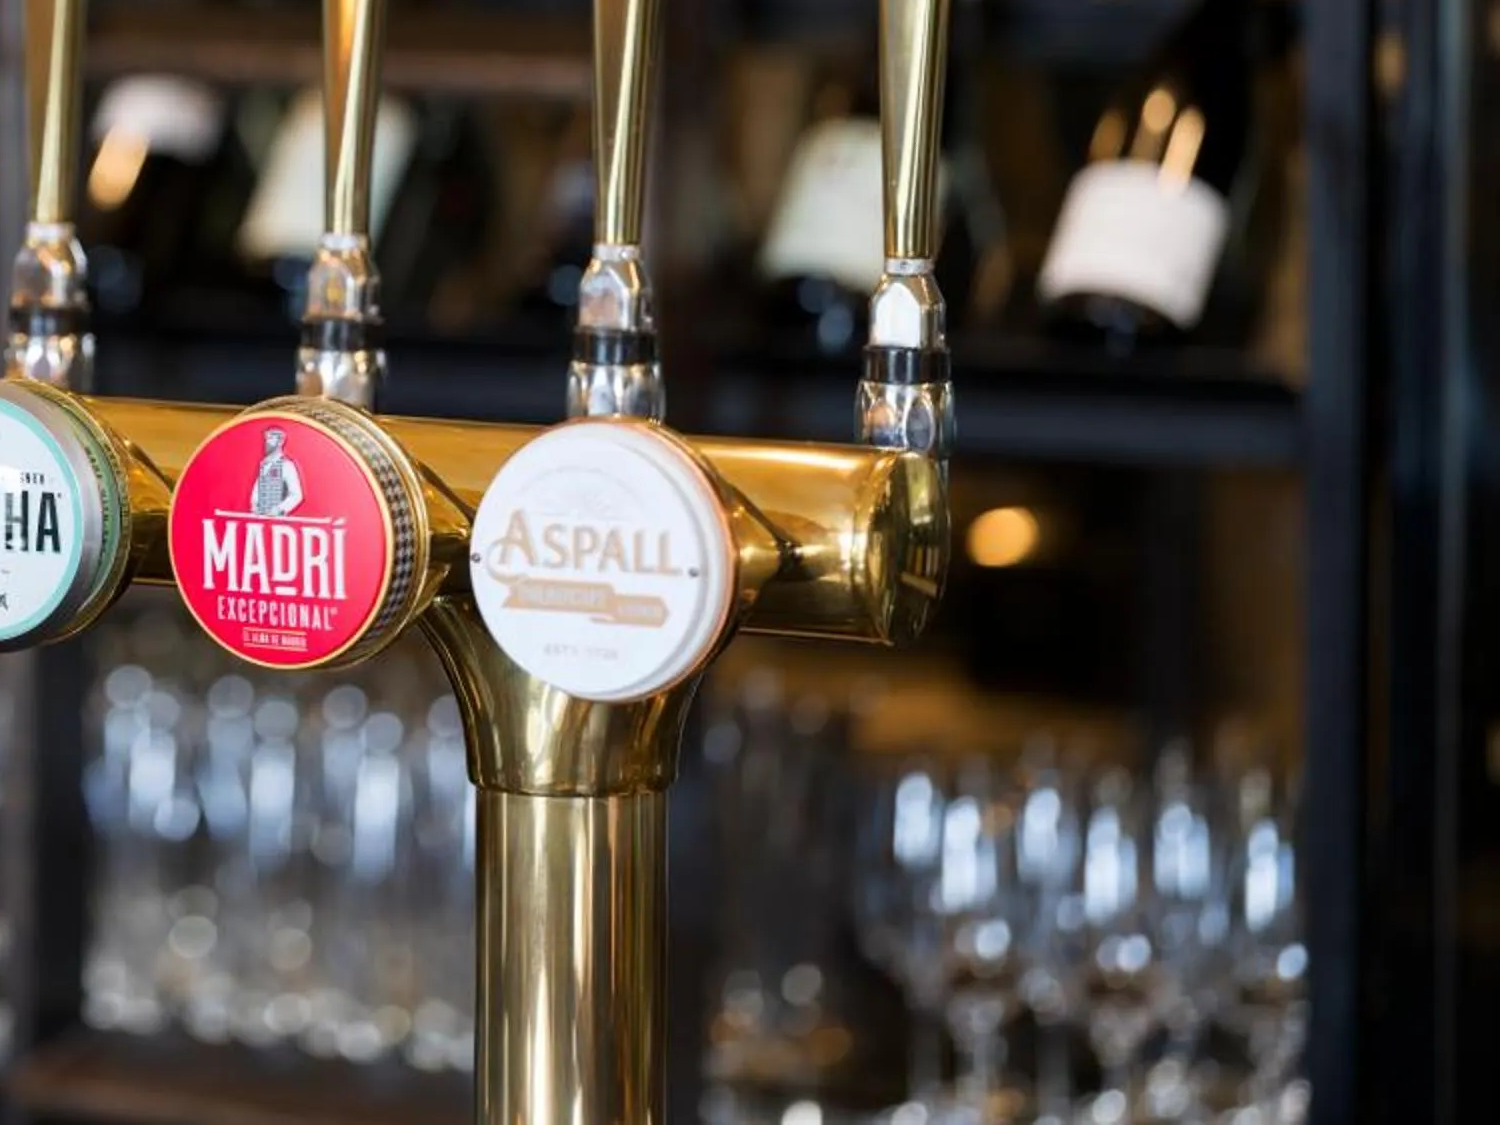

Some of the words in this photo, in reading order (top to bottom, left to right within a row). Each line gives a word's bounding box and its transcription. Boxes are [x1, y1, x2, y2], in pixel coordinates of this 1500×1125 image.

[200, 517, 348, 601] MADRÍ
[496, 508, 684, 577] ASPALL
[216, 595, 334, 632] EXCEPCIONAL
